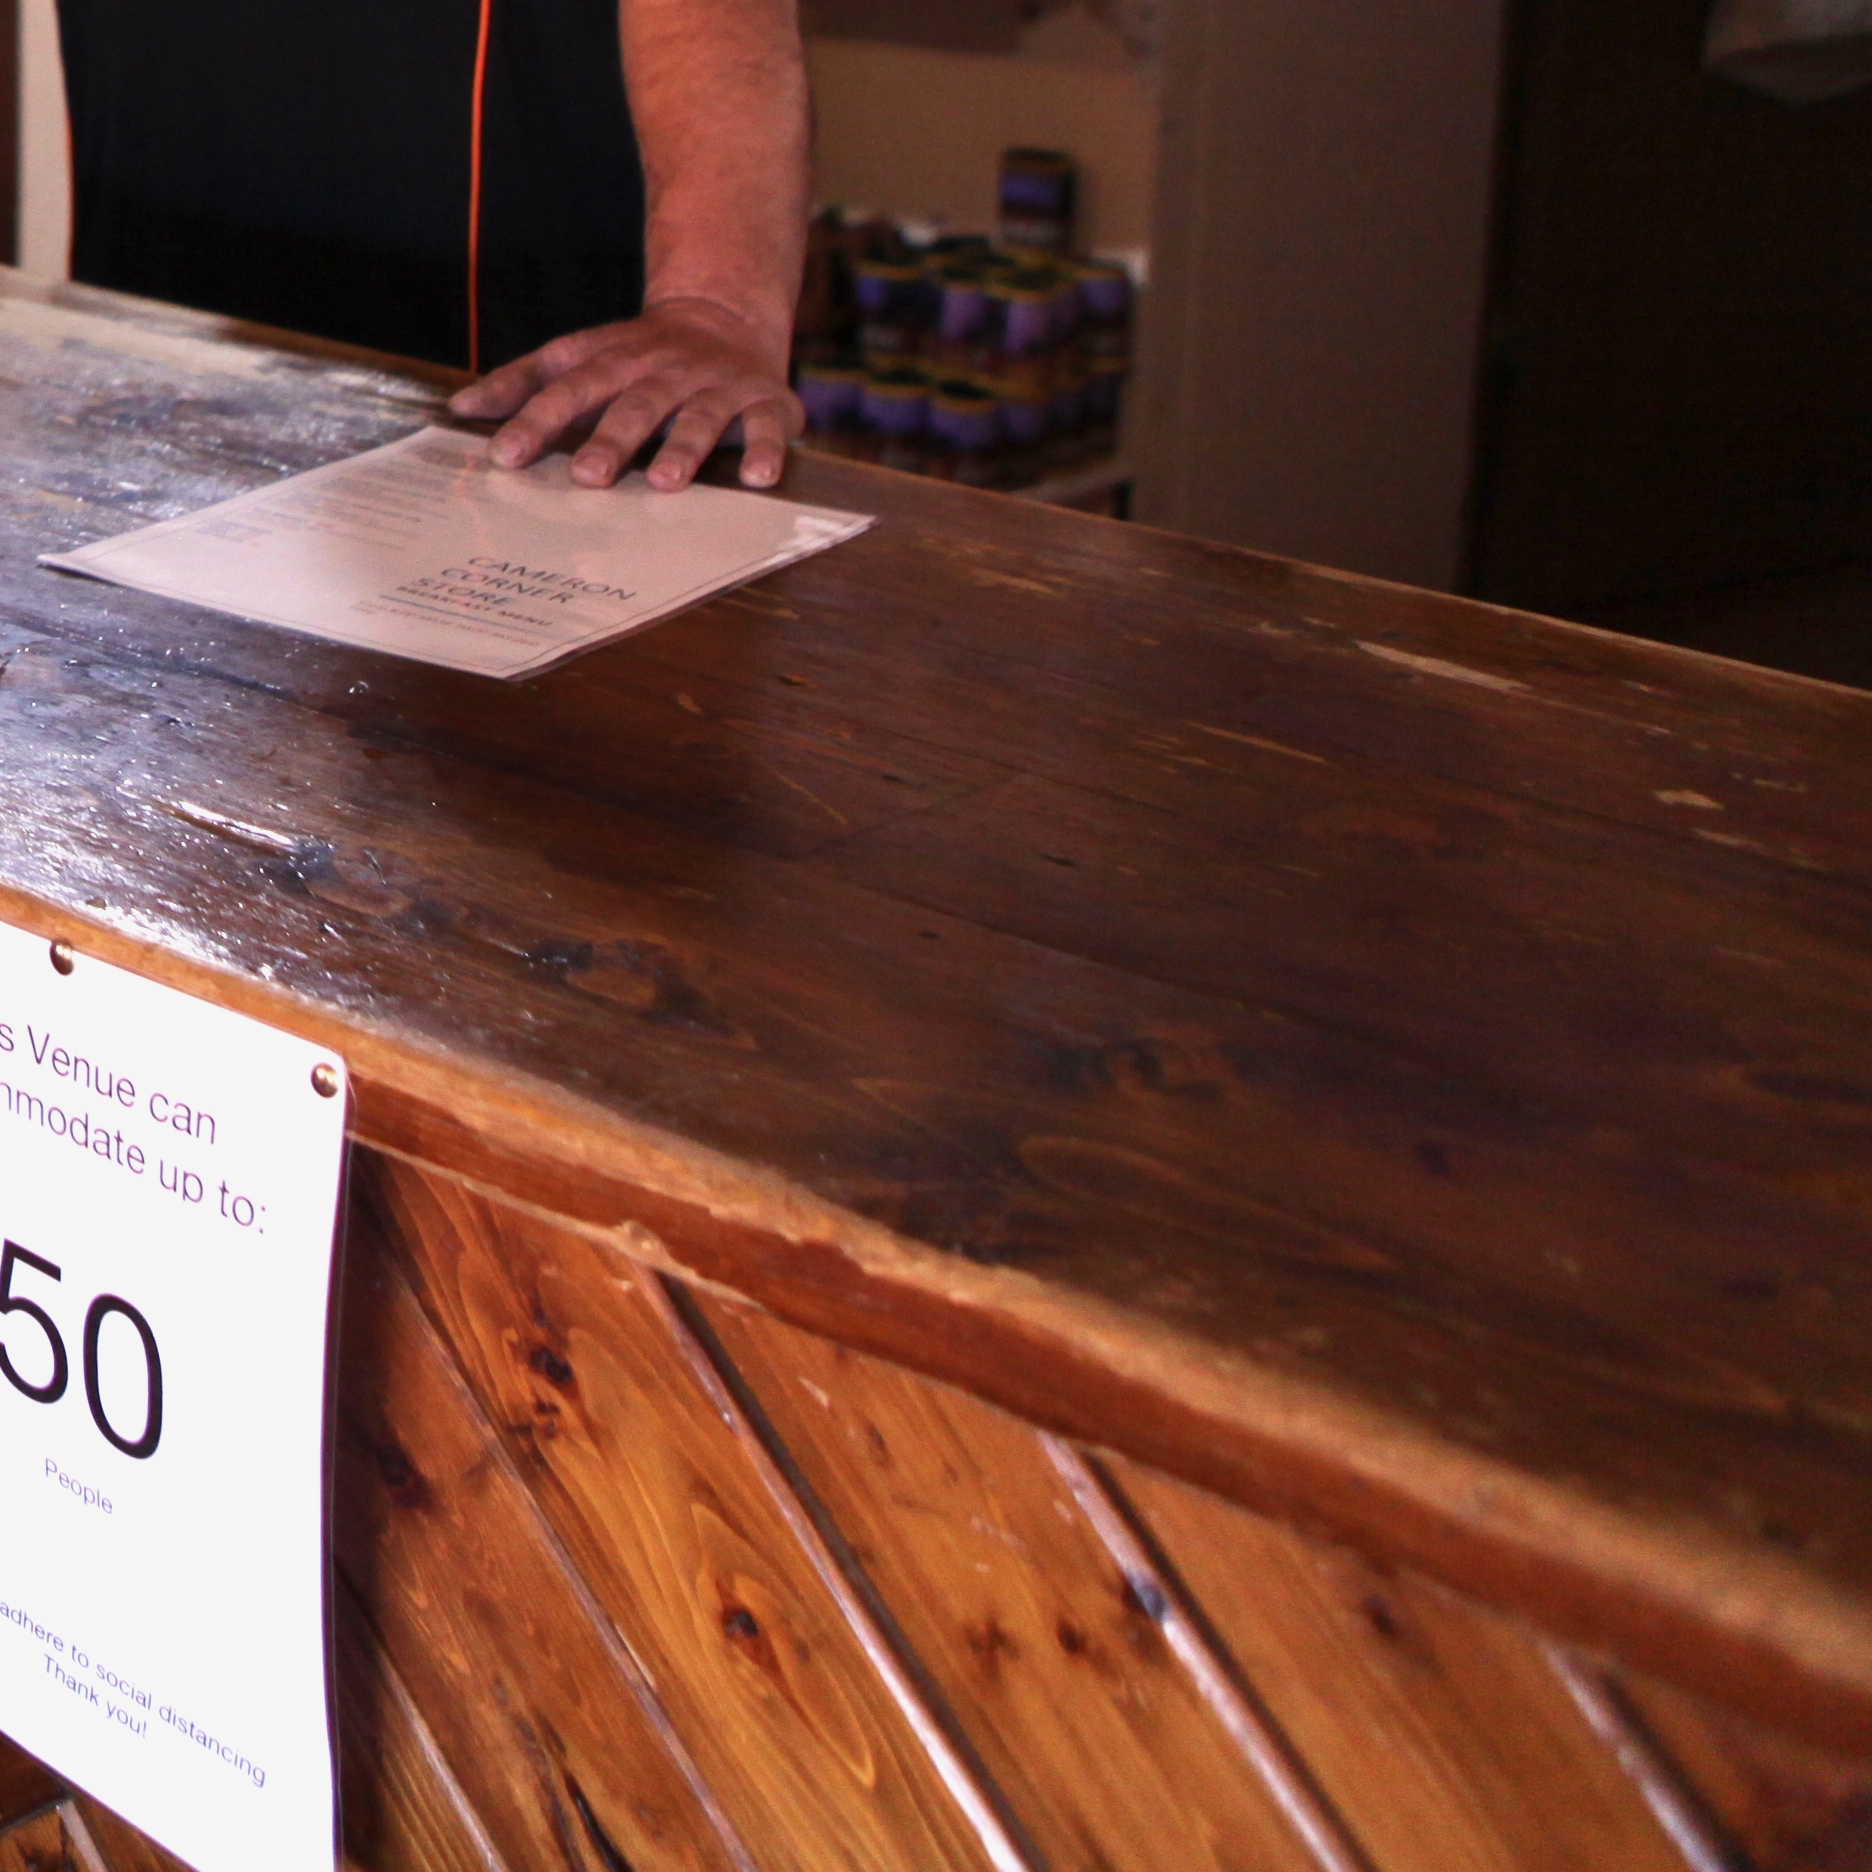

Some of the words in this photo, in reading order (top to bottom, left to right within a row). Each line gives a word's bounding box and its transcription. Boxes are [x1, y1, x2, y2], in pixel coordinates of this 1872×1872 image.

[411, 577, 518, 606] STORE
[441, 568, 575, 604] CORNER
[468, 557, 637, 601] CAMERON
[26, 1024, 136, 1108] Venue
[149, 1091, 217, 1146] can
[158, 1157, 204, 1204] up
[218, 1179, 268, 1234] to:
[44, 1457, 114, 1515] People
[0, 1600, 65, 1653] adhere
[71, 1644, 90, 1669] to
[95, 1662, 153, 1711] social
[158, 1703, 266, 1789] distancing
[44, 1653, 100, 1707] Thank
[105, 1699, 148, 1739] you!
